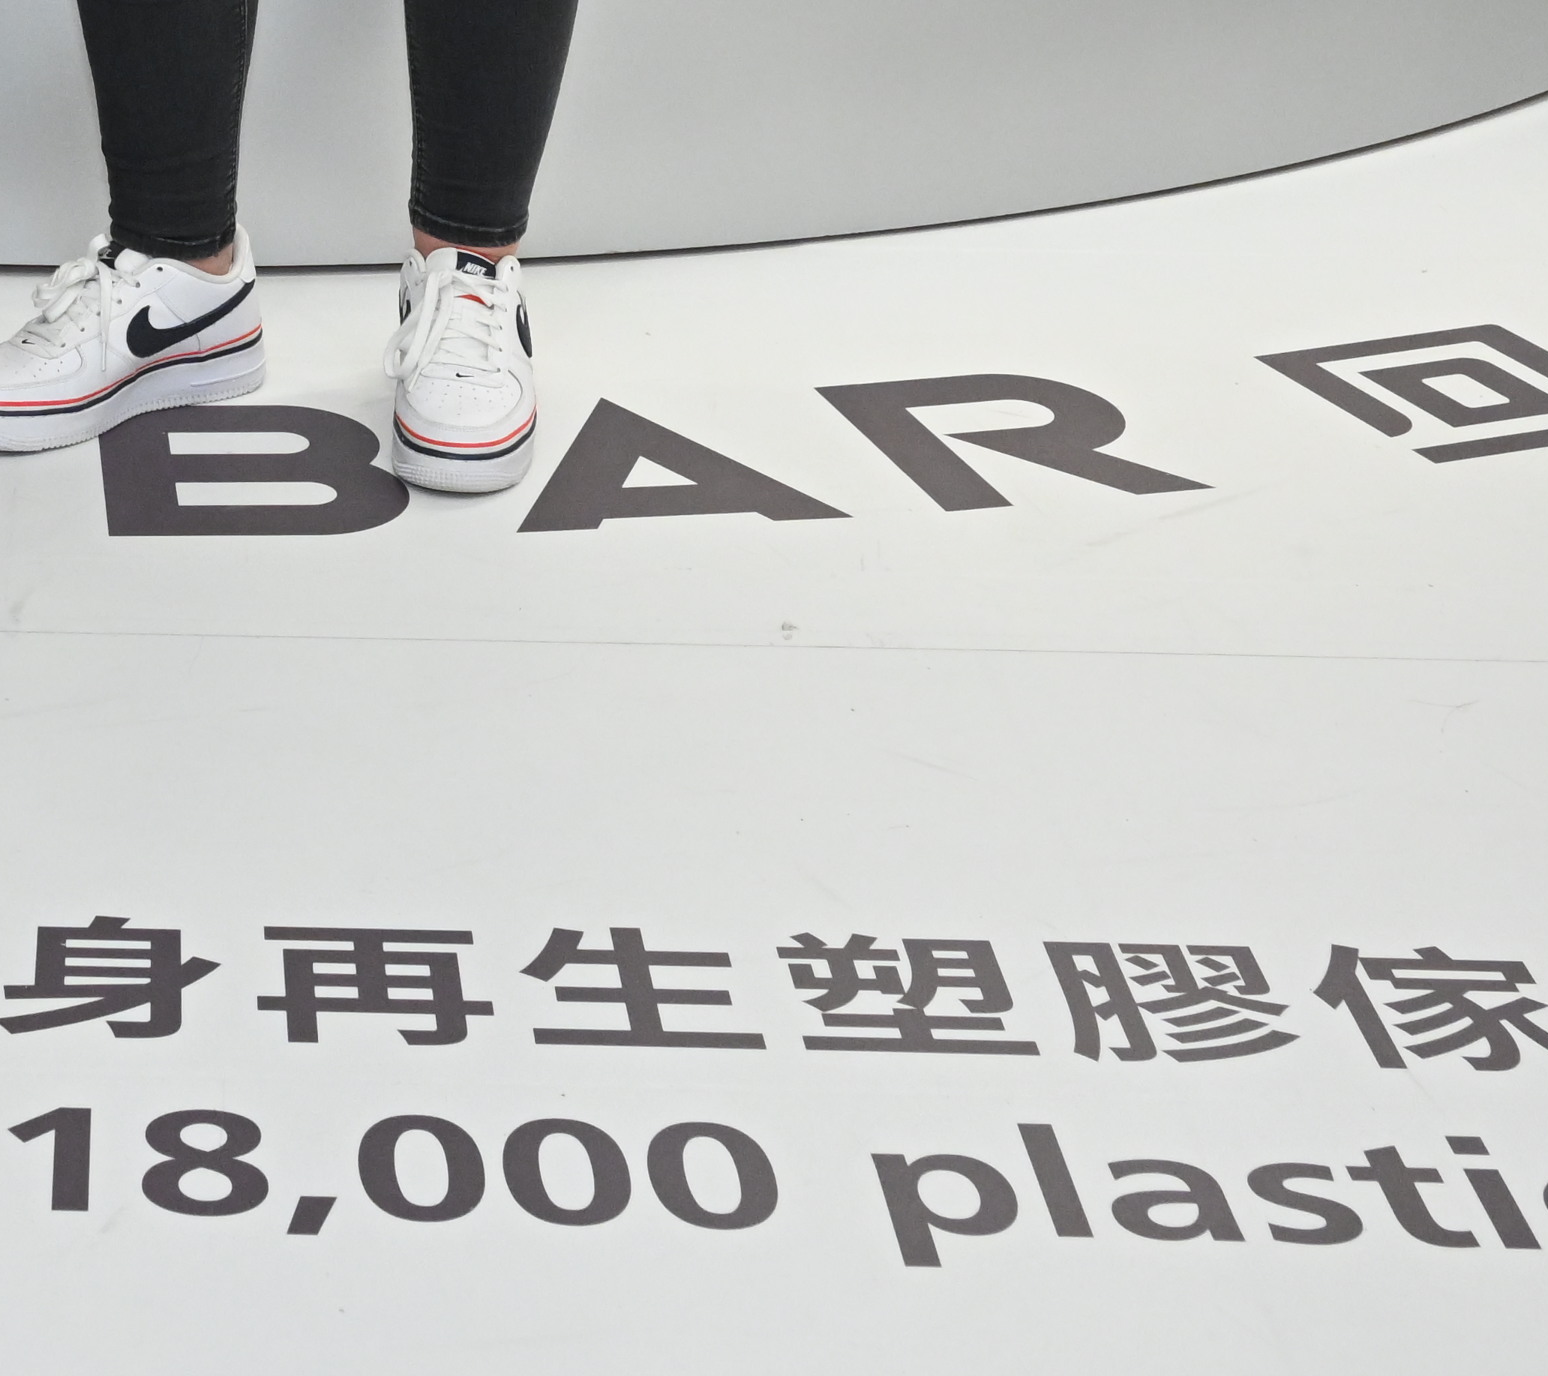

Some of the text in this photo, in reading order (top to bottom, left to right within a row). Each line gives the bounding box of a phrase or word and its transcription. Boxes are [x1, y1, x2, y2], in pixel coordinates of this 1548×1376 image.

[463, 261, 488, 276] NIKE
[101, 372, 1212, 537] BAR
[6, 1105, 780, 1237] 18,000
